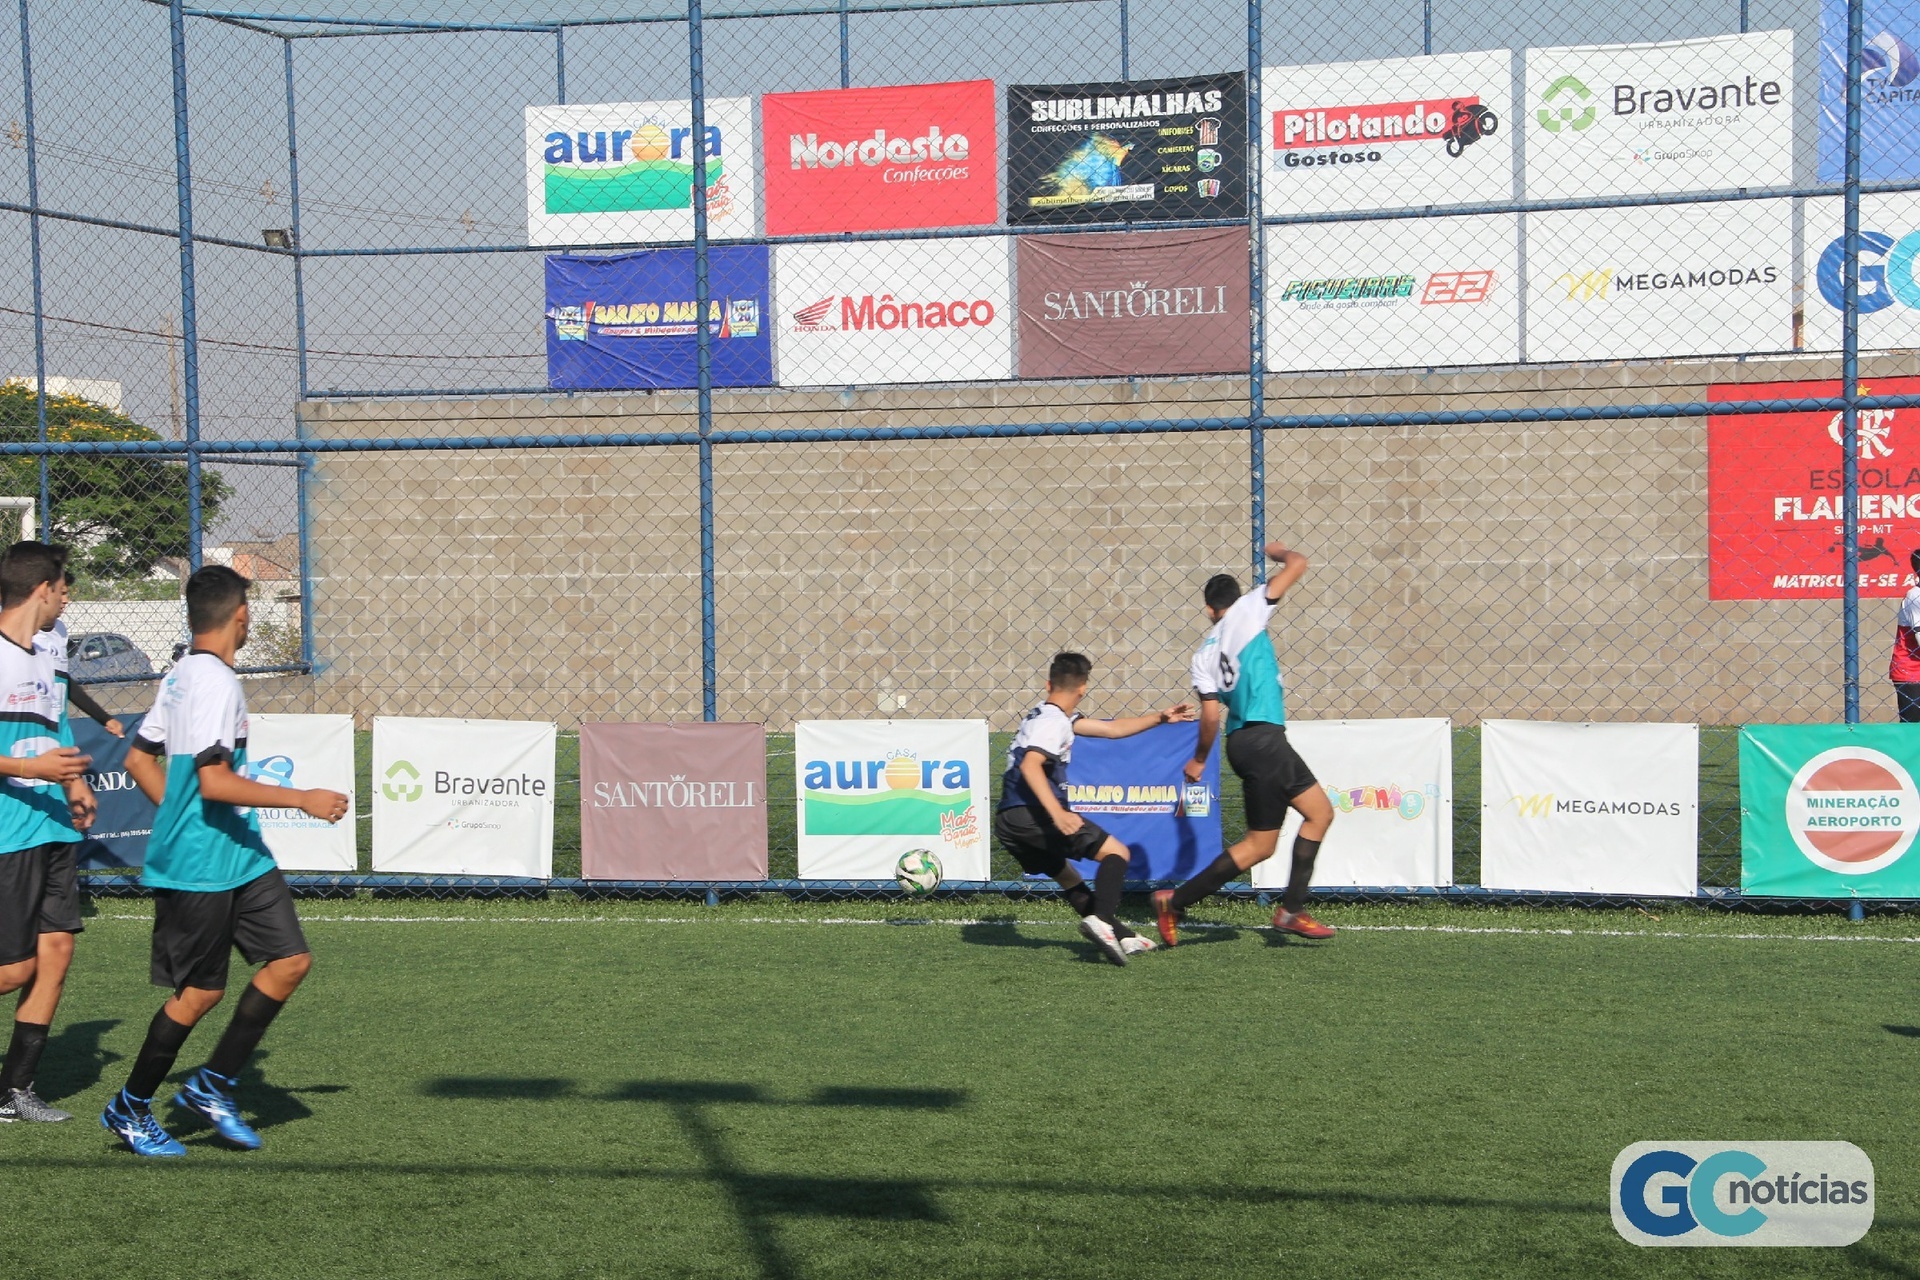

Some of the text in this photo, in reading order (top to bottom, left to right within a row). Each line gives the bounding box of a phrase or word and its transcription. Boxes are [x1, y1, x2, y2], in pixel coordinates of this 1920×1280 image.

[1031, 90, 1222, 121] SUBLIMALHAS
[1614, 75, 1781, 116] Bravante
[1865, 89, 1920, 104] CAPITA
[1283, 104, 1446, 144] Pilotando
[1638, 115, 1741, 130] URBANIZADORA
[790, 126, 969, 170] Nordeste
[1284, 150, 1382, 167] Gostoso
[883, 165, 969, 186] Confecções
[1164, 184, 1188, 193] COPOS
[1616, 266, 1777, 291] MEGAMODAS
[595, 300, 721, 324] BARATO MANA
[841, 294, 995, 331] Mônaco
[1044, 285, 1227, 320] SANTORELI
[793, 325, 838, 333] HONDA
[1810, 468, 1920, 490] ESOLA
[1773, 574, 1898, 588] MATRICUE-SE
[886, 748, 917, 761] CASA
[82, 771, 137, 792] RADO
[435, 771, 546, 796] Bravante
[451, 800, 520, 808] URBANIZADORA
[594, 781, 756, 808] SANTORELI
[1067, 785, 1124, 803] BARATO
[1126, 785, 1178, 803] MANIA
[1807, 795, 1900, 810] MINERAÇÃO
[1556, 800, 1681, 816] MEGAMODAS
[1807, 816, 1902, 827] AEROPORTO
